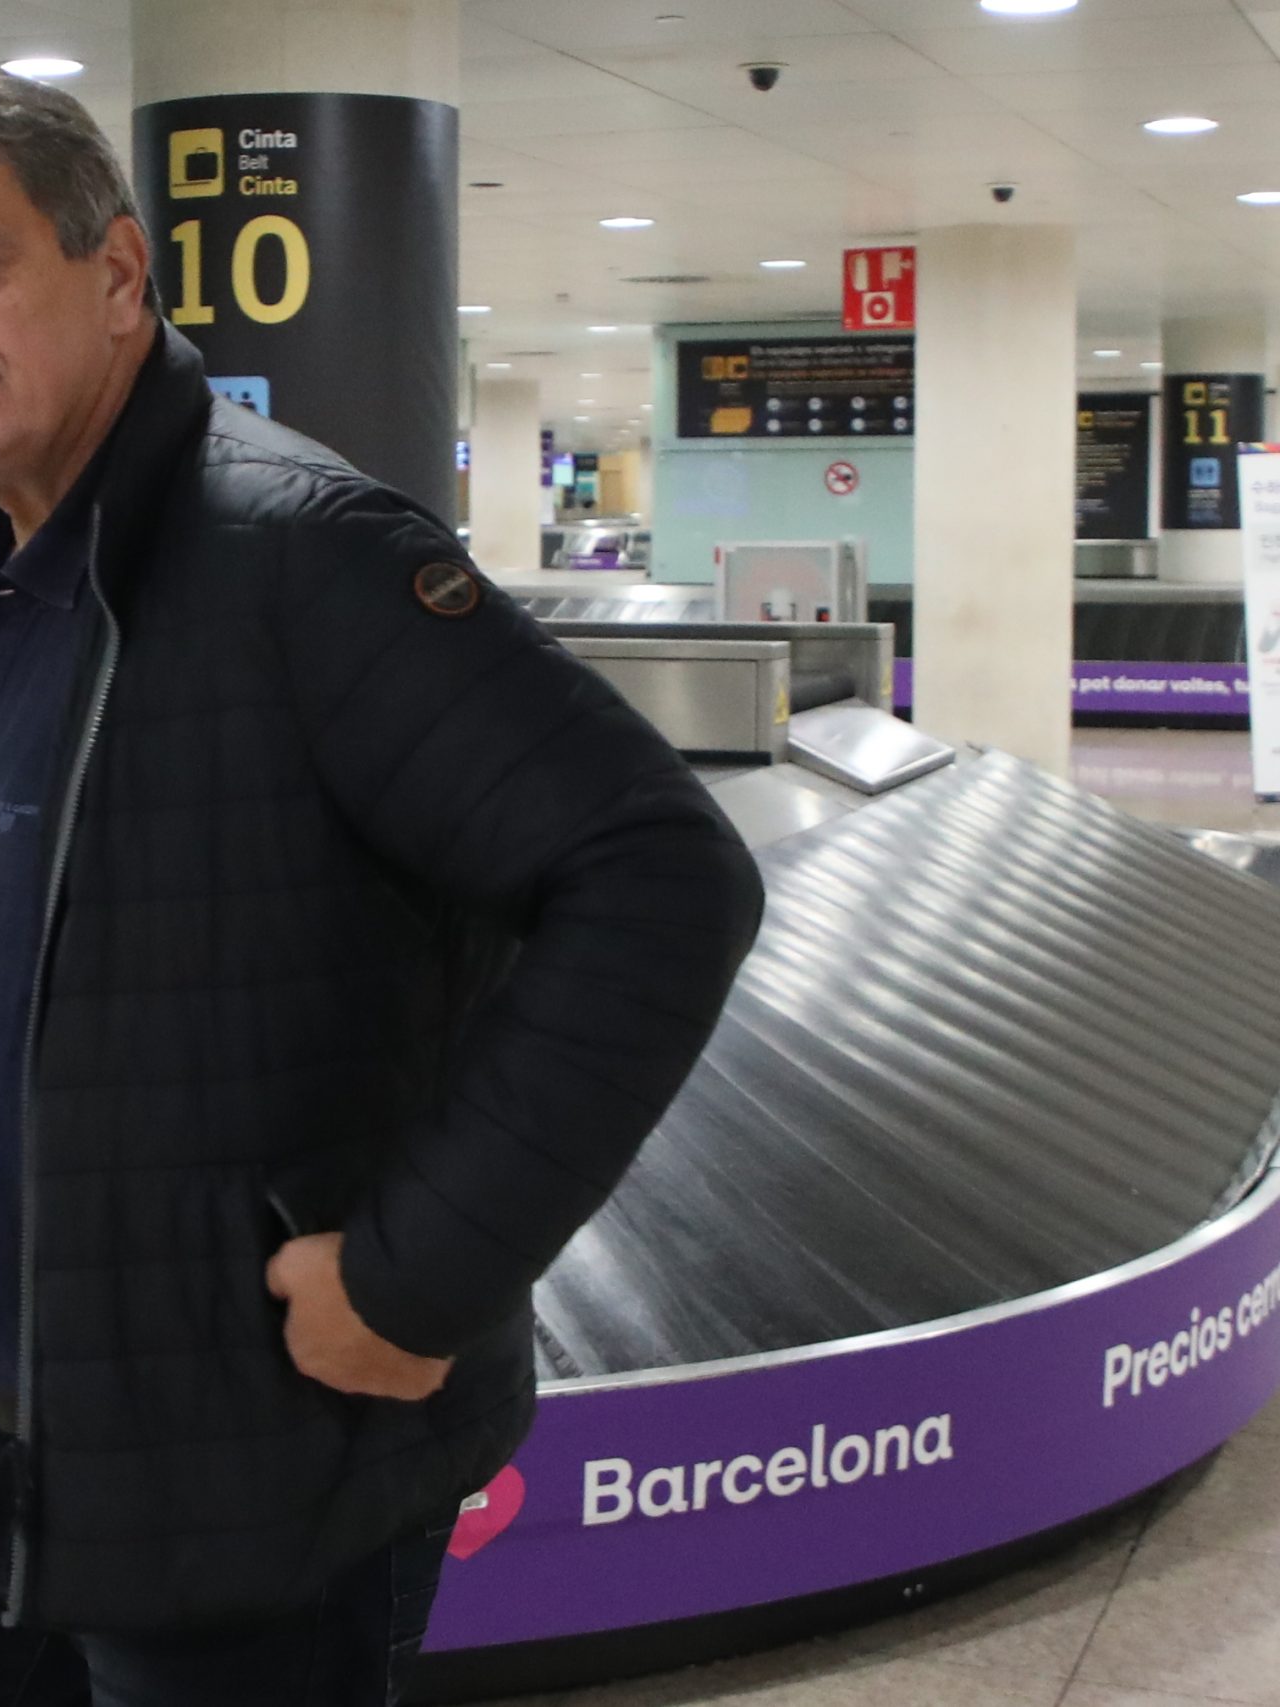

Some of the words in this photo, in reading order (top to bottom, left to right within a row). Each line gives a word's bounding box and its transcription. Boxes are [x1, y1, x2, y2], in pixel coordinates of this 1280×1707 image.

[239, 129, 297, 149] Cinta
[238, 153, 269, 171] Belt
[239, 175, 298, 195] Cinta
[170, 213, 311, 326] 10
[1182, 409, 1230, 445] 11
[1078, 675, 1111, 695] pot
[1112, 675, 1168, 694] donar
[1169, 676, 1231, 696] voltes,
[1102, 1306, 1233, 1409] Precios
[582, 1413, 954, 1526] Barcelona
